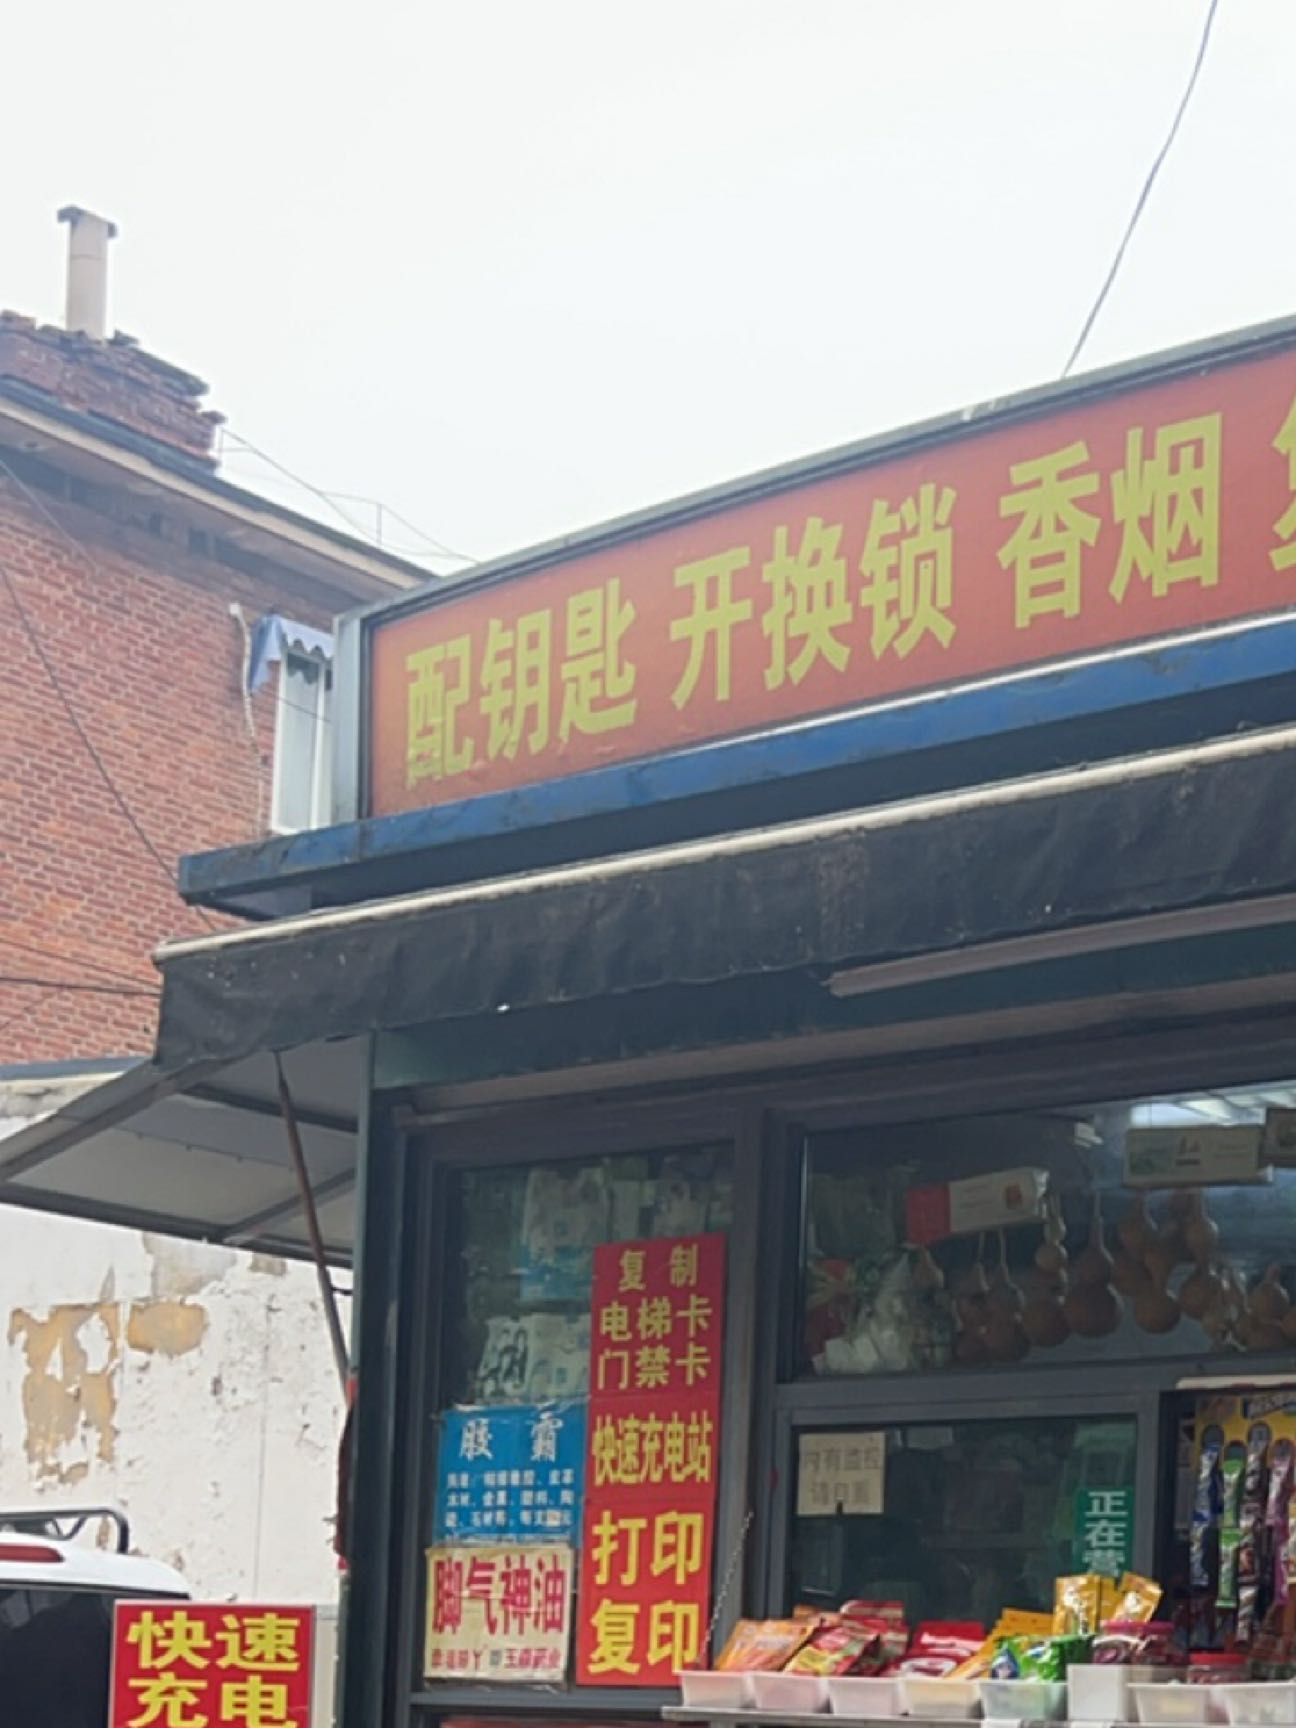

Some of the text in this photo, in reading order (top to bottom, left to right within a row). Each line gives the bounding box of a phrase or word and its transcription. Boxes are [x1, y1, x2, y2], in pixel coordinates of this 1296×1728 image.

[404, 577, 638, 790] 配钥匙
[668, 482, 957, 711] 开换锁
[997, 411, 1223, 630] 香烟
[618, 1243, 699, 1293] 复制
[600, 1294, 712, 1343] 电梯卡
[597, 1343, 712, 1390] 门禁卡
[591, 1410, 714, 1488] 快速充电站
[591, 1510, 704, 1586] 打印
[432, 1552, 566, 1636] 脚气神油
[126, 1608, 301, 1673] 快速
[587, 1599, 700, 1675] 复印
